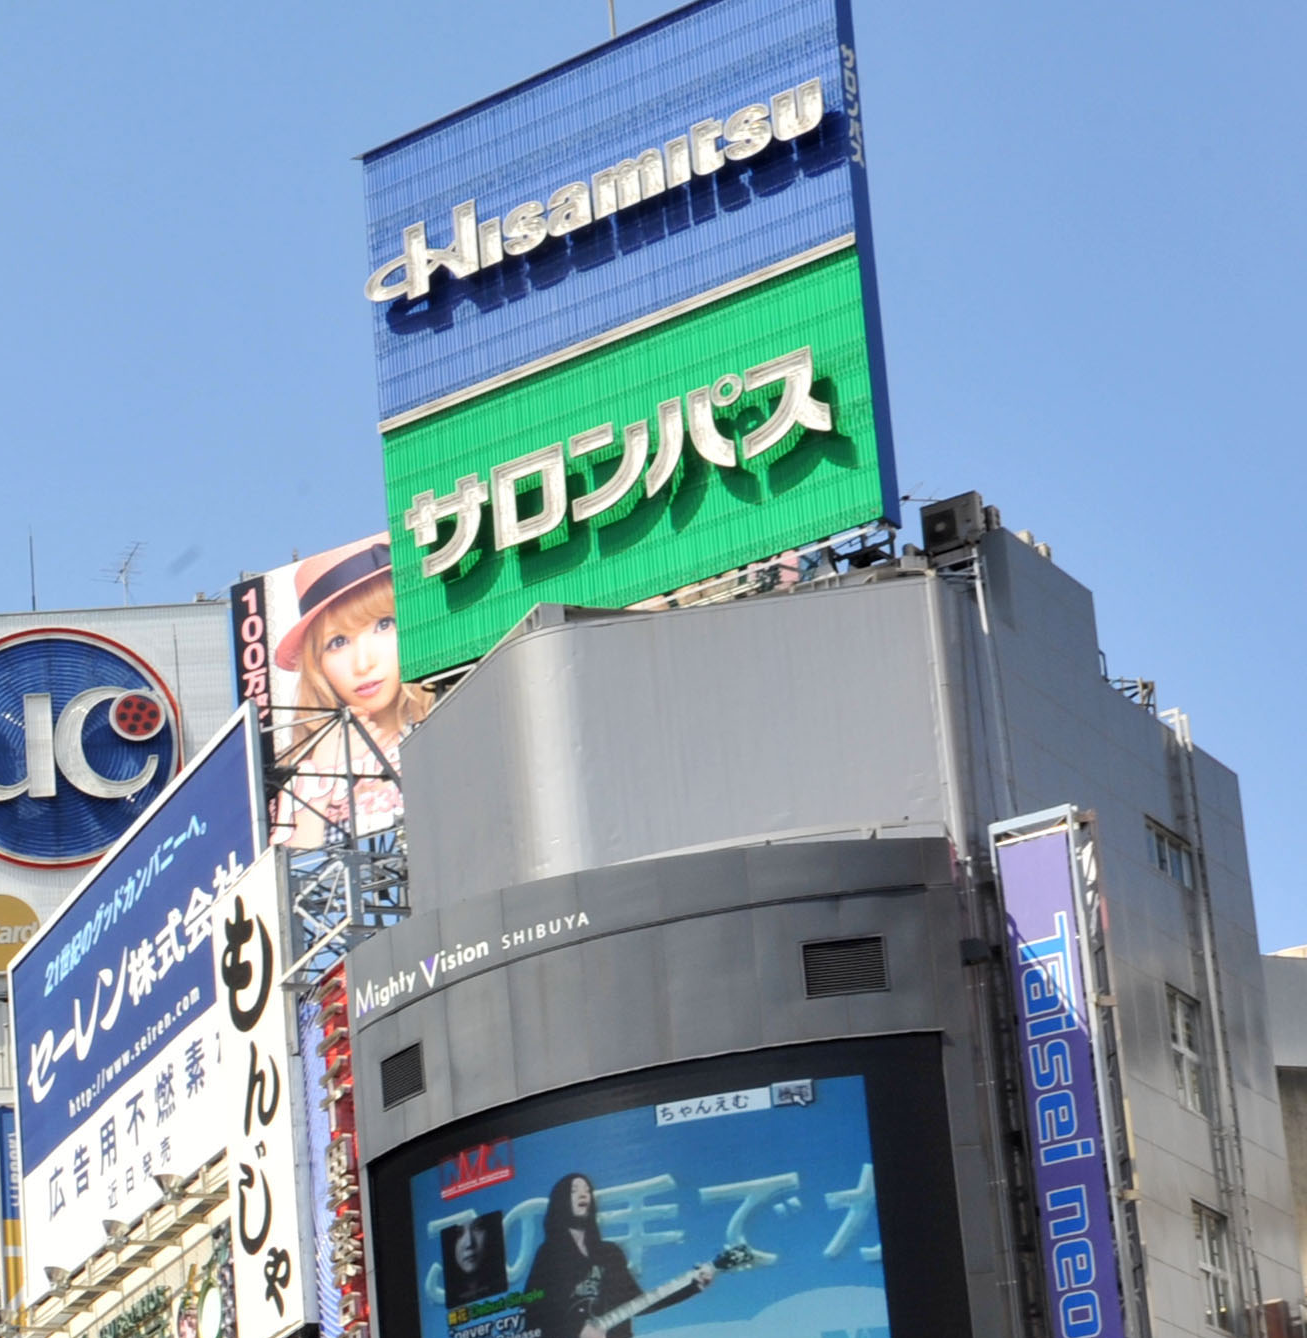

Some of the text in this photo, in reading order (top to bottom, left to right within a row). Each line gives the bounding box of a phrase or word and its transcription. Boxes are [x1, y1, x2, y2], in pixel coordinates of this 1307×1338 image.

[364, 77, 822, 302] Hisamitsu
[405, 345, 832, 578] サロンパス
[355, 911, 590, 1019] Mighty Vision SHIBUYA
[1019, 910, 1095, 1166] Taisei
[221, 894, 291, 1318] もんじゃ
[660, 1094, 750, 1122] ちゃんえむ
